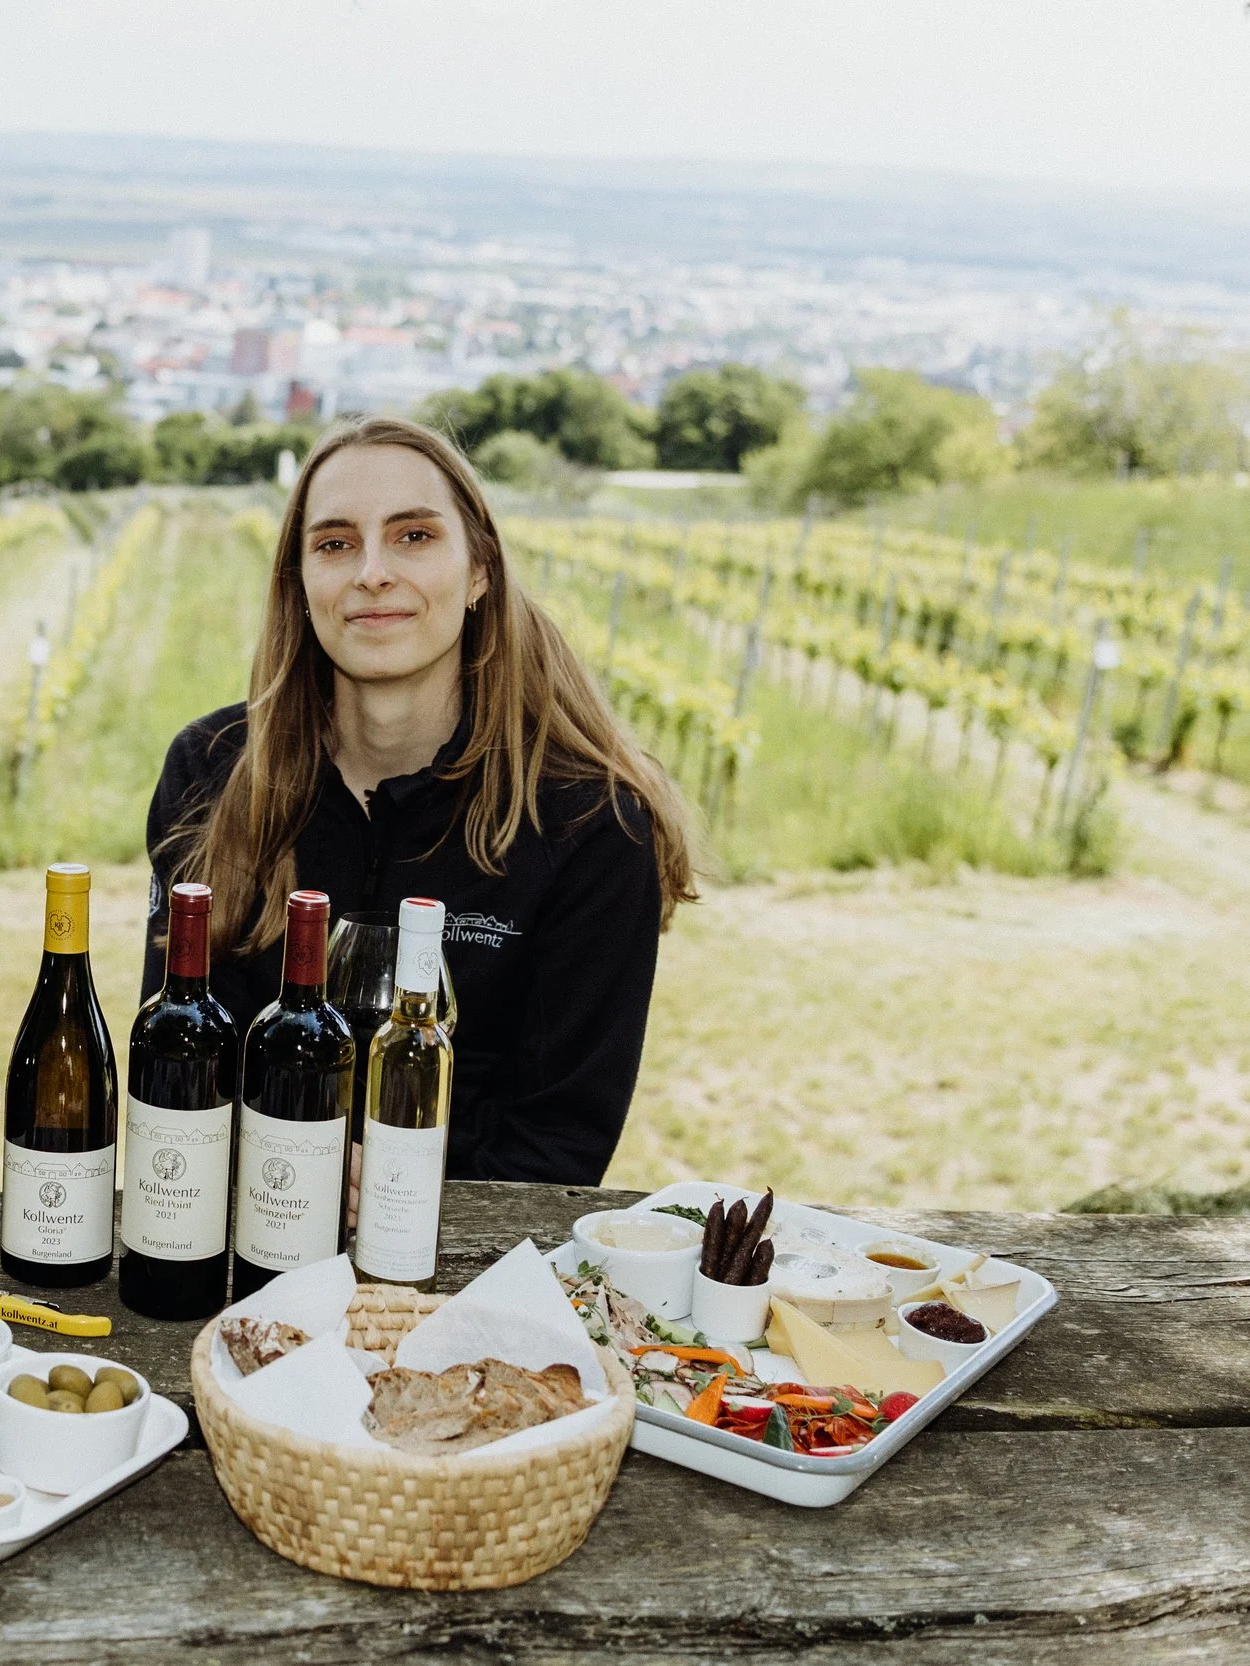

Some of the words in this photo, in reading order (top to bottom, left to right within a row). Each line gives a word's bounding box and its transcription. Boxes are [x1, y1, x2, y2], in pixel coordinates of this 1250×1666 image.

[441, 926, 503, 948] ollwentz
[138, 1178, 201, 1198] Kollwentz
[144, 1195, 165, 1207] Ried
[167, 1200, 192, 1209] Point
[249, 1186, 310, 1209] Kollwentz
[23, 1208, 84, 1224] Kollwentz
[155, 1209, 177, 1220] 2021
[265, 1219, 286, 1230] 2021
[41, 1237, 61, 1246] 2023
[141, 1235, 192, 1250] Burgenland
[31, 1248, 72, 1258] Burgenland
[250, 1243, 300, 1261] Burgenland
[1, 1307, 58, 1330] kollwentz.at
